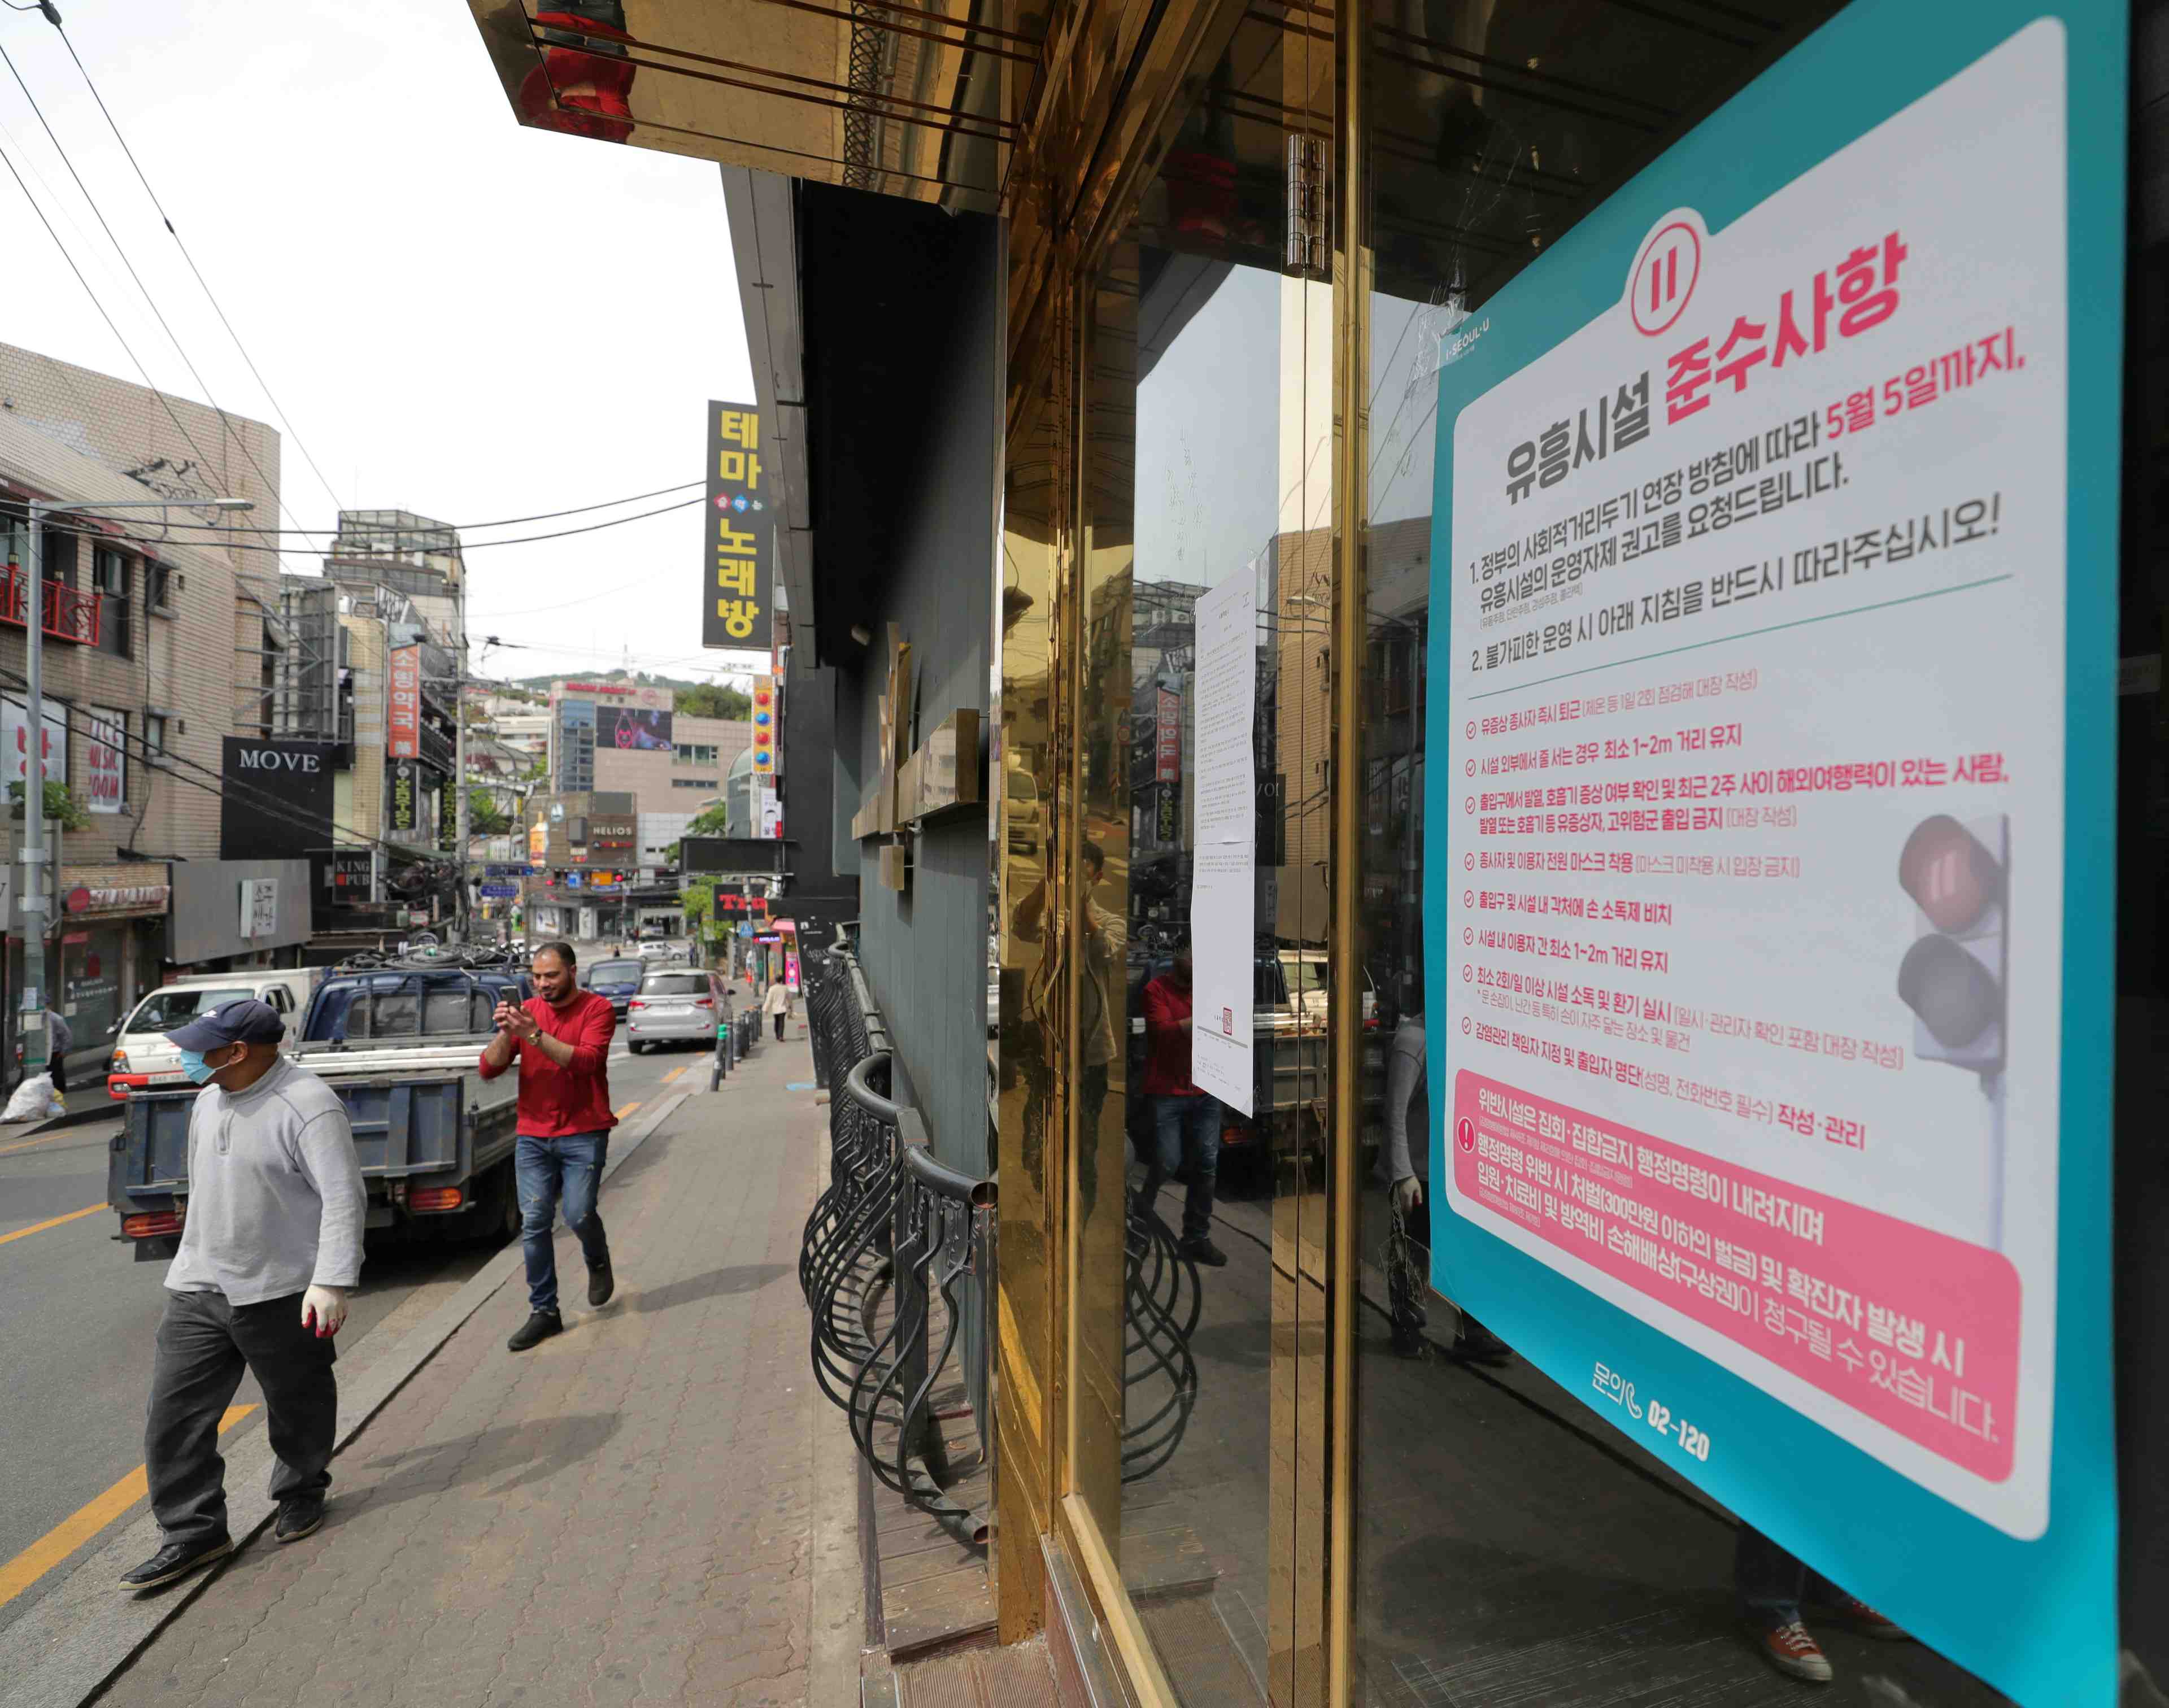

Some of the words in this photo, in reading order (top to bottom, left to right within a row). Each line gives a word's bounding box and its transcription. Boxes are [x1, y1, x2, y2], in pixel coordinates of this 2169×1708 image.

[1506, 370, 1650, 506] 유흥시설
[1665, 231, 1907, 425] 준수사항
[721, 410, 762, 490] 테마
[1469, 561, 1479, 584] 1.
[1481, 540, 1520, 581] 정부의
[1523, 487, 1637, 561] 사회적거리두기
[1643, 468, 1684, 514] 연장
[1689, 436, 1759, 495] 방침에
[1766, 411, 1820, 464] 따라
[1827, 386, 1874, 439] 5월
[1480, 563, 1547, 613] 유흥시설의
[1550, 535, 1617, 588] 운영자제
[1621, 511, 1682, 562] 권고를
[1687, 451, 1848, 539] 요청드립니다.
[717, 517, 760, 638] 노래방
[1471, 650, 1482, 672] 2.
[1486, 630, 1539, 669] 불가피한
[1543, 619, 1571, 653] 운영
[1576, 612, 1592, 642] 시
[1599, 600, 1634, 636] 아래
[1640, 581, 1703, 625] 지침을
[1711, 556, 1783, 608] 반드시
[1794, 493, 2000, 585] 따라주십시오!
[1481, 715, 1508, 735] 유증상
[1509, 709, 1536, 731] 종사자
[1538, 704, 1556, 724] 즉시
[1558, 699, 1580, 721] 퇴근
[1607, 695, 1618, 713] 등
[1637, 687, 1655, 707] 2회
[1658, 681, 1694, 705] 점검해
[1696, 676, 1722, 697] 대장
[1726, 668, 1757, 691] 작성)
[239, 750, 320, 773] MOVE
[1480, 757, 1499, 775] 시설
[1501, 751, 1537, 773] 외부에서
[1539, 749, 1548, 768] 줄
[1551, 747, 1573, 766] 서는
[1575, 742, 1599, 764] 경우
[1604, 739, 1629, 759] 최소
[1632, 734, 1672, 756] 1~2m
[1676, 728, 1705, 751] 거리
[1709, 722, 1741, 748] 유지
[1480, 791, 1522, 811] 출입구에서
[1545, 786, 1577, 806] 호흡기
[1580, 784, 1602, 805] 증상
[1605, 782, 1629, 801] 여부
[1632, 779, 1658, 801] 확인
[1662, 778, 1675, 799] 및
[1678, 775, 1707, 798] 최근
[1710, 774, 1736, 796] 2주
[1740, 770, 1772, 795] 사이
[1777, 761, 1895, 792] 해외여행력이
[1901, 759, 1947, 786] 있는
[90, 774, 118, 799] OOM
[1479, 817, 1496, 834] 발열
[1497, 817, 1515, 834] 또는
[1517, 815, 1543, 834] 호흡기
[1545, 814, 1555, 833] 등
[1608, 809, 1658, 831] 고위험군
[1661, 808, 1689, 830] 출입
[1692, 807, 1722, 830] 금지
[1726, 806, 1759, 827] (대장
[1762, 805, 1797, 827] 작성)
[337, 861, 370, 872] KING
[593, 826, 632, 836] HELIOS
[1479, 851, 1505, 868] 종사자
[1507, 852, 1515, 869] 및
[1517, 852, 1545, 870] 이용자
[1547, 852, 1567, 871] 전원
[1570, 852, 1605, 872] 마스크
[1609, 852, 1632, 873] 착용
[1635, 854, 1674, 873] (마스크
[1676, 855, 1713, 875] 미착용
[1717, 856, 1730, 875] 시
[1734, 856, 1762, 877] 입장
[1764, 856, 1800, 878] 금지)
[346, 874, 370, 886] PUB
[1479, 890, 1505, 909] 출입구
[1507, 893, 1515, 910] 및
[1517, 895, 1536, 913] 시설
[1538, 896, 1548, 914] 내
[1550, 896, 1584, 917] 각처에
[1587, 899, 1599, 919] 손
[1601, 900, 1640, 922] 소독제
[1644, 903, 1671, 925] 비치
[1478, 929, 1495, 948] 시설
[1497, 932, 1506, 949] 내
[1508, 933, 1535, 953] 이용자
[1537, 936, 1548, 956] 간
[1549, 938, 1571, 959] 최소
[1574, 942, 1608, 964] 1~2m
[1611, 945, 1637, 968] 거리
[1640, 949, 1667, 973] 유지
[1477, 966, 1494, 986] 최소
[1496, 970, 1522, 993] 2회/일
[1525, 975, 1545, 997] 이상
[1547, 981, 1568, 1003] 시설
[1570, 985, 1594, 1008] 소독
[1598, 989, 1609, 1010] 및
[1613, 992, 1639, 1017] 환기
[1643, 998, 1671, 1023] 실시
[1754, 1021, 1783, 1045] 확인
[1788, 1026, 1819, 1052] 포함
[1823, 1032, 1857, 1060] 대장
[1861, 1040, 1904, 1070] 작성)
[1476, 1022, 1509, 1047] 감염관리
[1512, 1032, 1539, 1056] 책임자
[1541, 1040, 1561, 1064] 지정
[1563, 1047, 1574, 1068] 및
[1577, 1051, 1613, 1078] 출입자
[1676, 1078, 1732, 1112] 전화번호
[1736, 1093, 1773, 1125] 필수)
[1478, 1087, 1536, 1131] 위반시설은
[1636, 1145, 1727, 1208] 행정명령이
[1732, 1181, 1824, 1245] 내려지며
[1477, 1132, 1523, 1174] 행정명령
[1525, 1154, 1552, 1187] 위반
[1553, 1166, 1567, 1195] 시
[1571, 1173, 1658, 1235] 처벌(300만원
[1661, 1214, 1711, 1260] 이하의
[1714, 1237, 1757, 1281] 벌금)
[1761, 1255, 1782, 1293] 및
[1787, 1267, 1863, 1331] 확진자
[1867, 1302, 1924, 1358] 발생
[1931, 1331, 1964, 1377] 시
[1544, 1192, 1557, 1221] 및
[1560, 1201, 1604, 1245] 방역비
[1763, 1297, 1831, 1361] 청구될
[1836, 1337, 1864, 1372] 수
[1869, 1349, 1998, 1443] 있습니다.
[1592, 1361, 1626, 1405] 문의
[1648, 1400, 1710, 1462] 02-120
